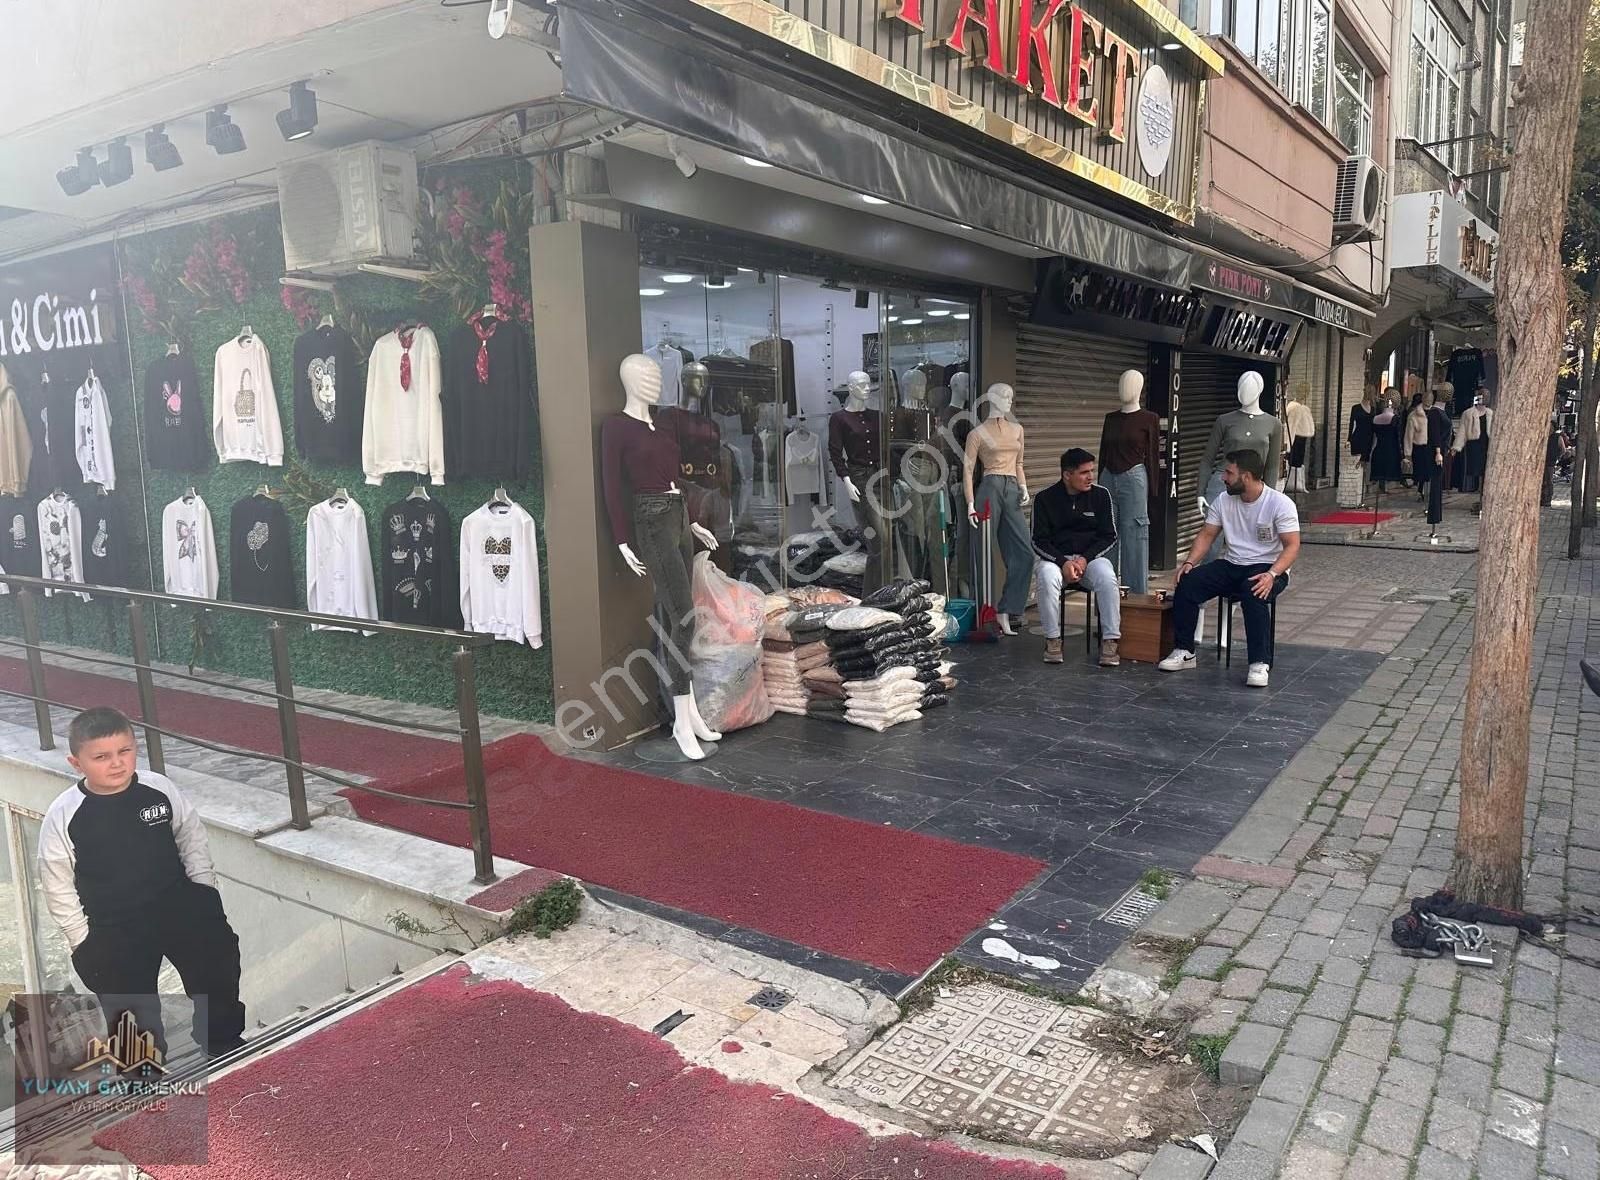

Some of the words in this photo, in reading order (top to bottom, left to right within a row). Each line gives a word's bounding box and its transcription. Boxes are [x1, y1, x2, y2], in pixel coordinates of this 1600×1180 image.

[896, 0, 1138, 142] AKET
[1219, 266, 1240, 292] PINK
[1241, 273, 1263, 298] PONY
[0, 288, 103, 355] &Cimi
[1212, 306, 1265, 354] MODA
[1314, 297, 1335, 322] MODA
[1335, 304, 1349, 327] ELA
[1172, 352, 1181, 433] MODA
[1170, 442, 1178, 498] ELA
